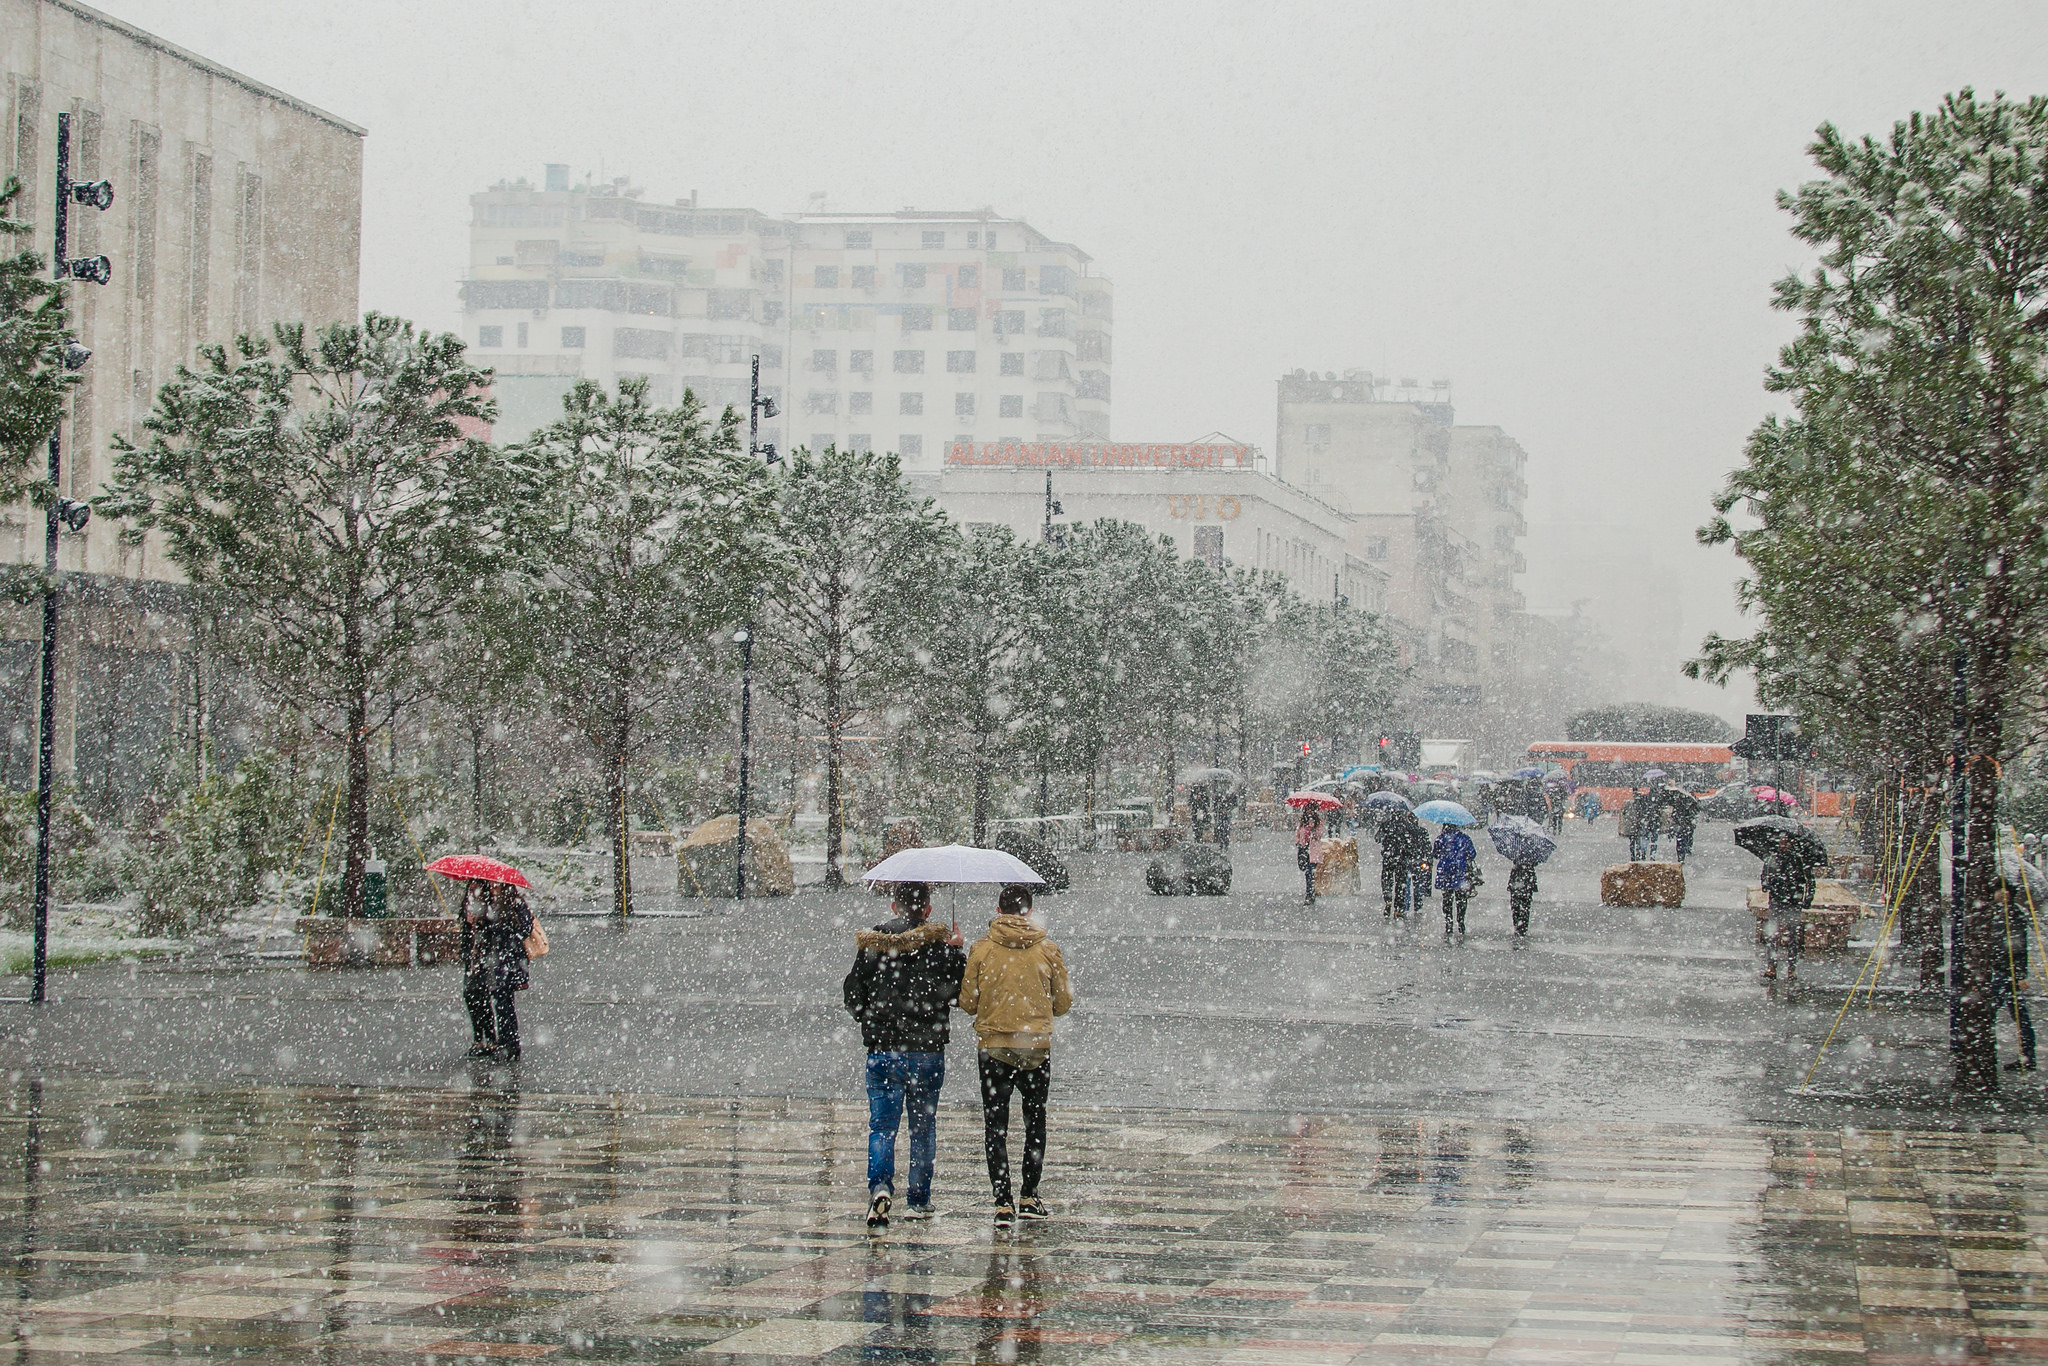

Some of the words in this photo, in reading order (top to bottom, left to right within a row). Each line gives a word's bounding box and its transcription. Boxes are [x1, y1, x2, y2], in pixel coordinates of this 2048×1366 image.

[948, 442, 1082, 466] ALBANIAN
[1091, 443, 1248, 467] UNIVERSITY
[1168, 495, 1241, 520] UFO
